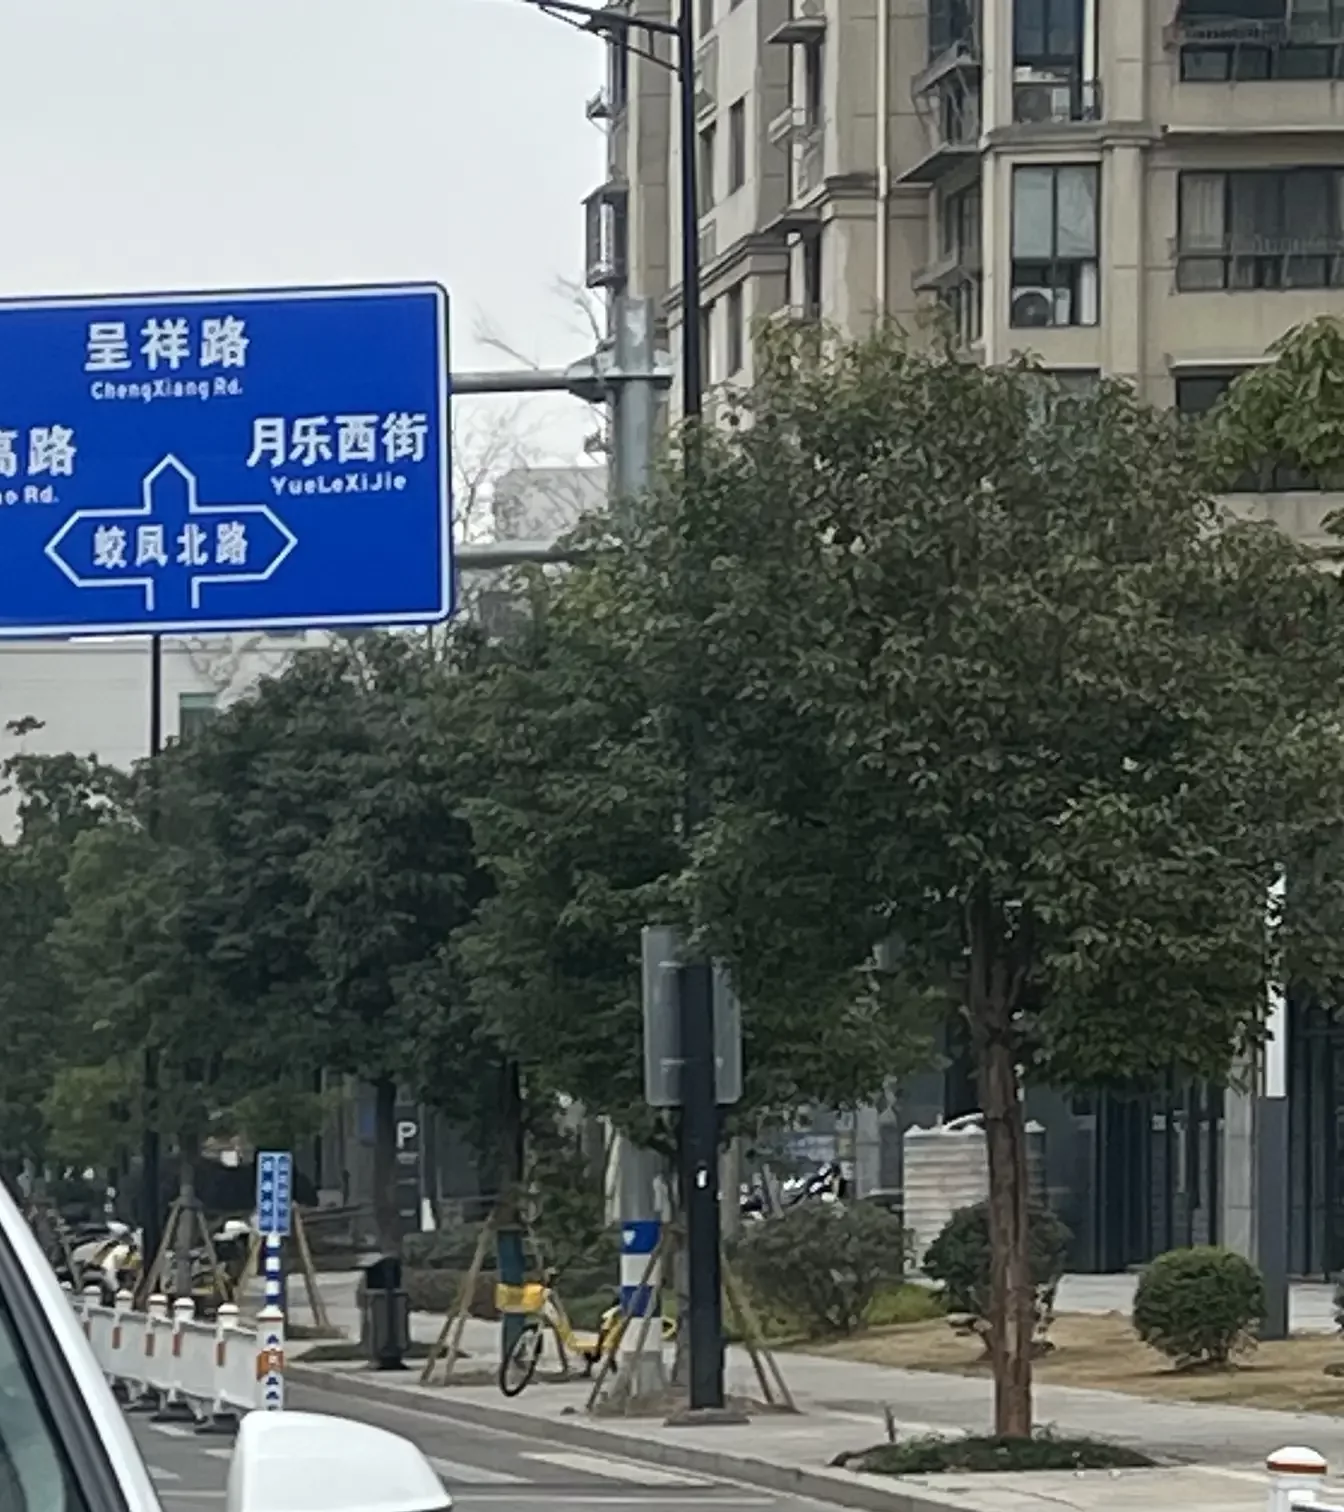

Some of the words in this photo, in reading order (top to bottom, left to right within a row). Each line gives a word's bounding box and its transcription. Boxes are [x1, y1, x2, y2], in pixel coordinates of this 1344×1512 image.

[84, 315, 250, 371] 呈祥路
[90, 378, 210, 404] ChengXiang
[213, 376, 243, 396] Rd.
[246, 411, 429, 468] 月乐西街
[23, 484, 60, 503] Rd.
[396, 1121, 417, 1149] P
